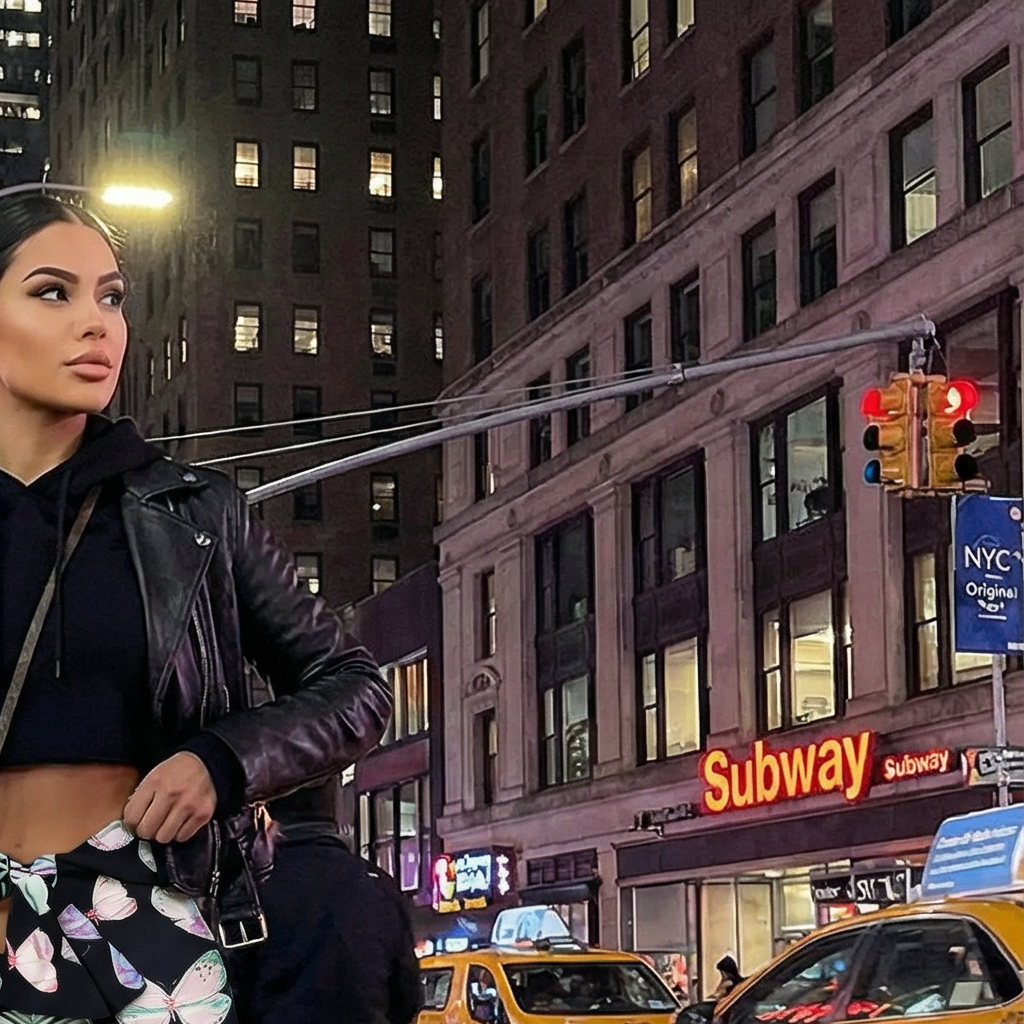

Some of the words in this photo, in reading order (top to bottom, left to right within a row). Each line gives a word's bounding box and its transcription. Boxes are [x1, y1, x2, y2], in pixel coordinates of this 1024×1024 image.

[964, 545, 1011, 571] NYC
[965, 581, 1018, 601] Original
[703, 731, 872, 812] Subway
[884, 749, 950, 781] Subway
